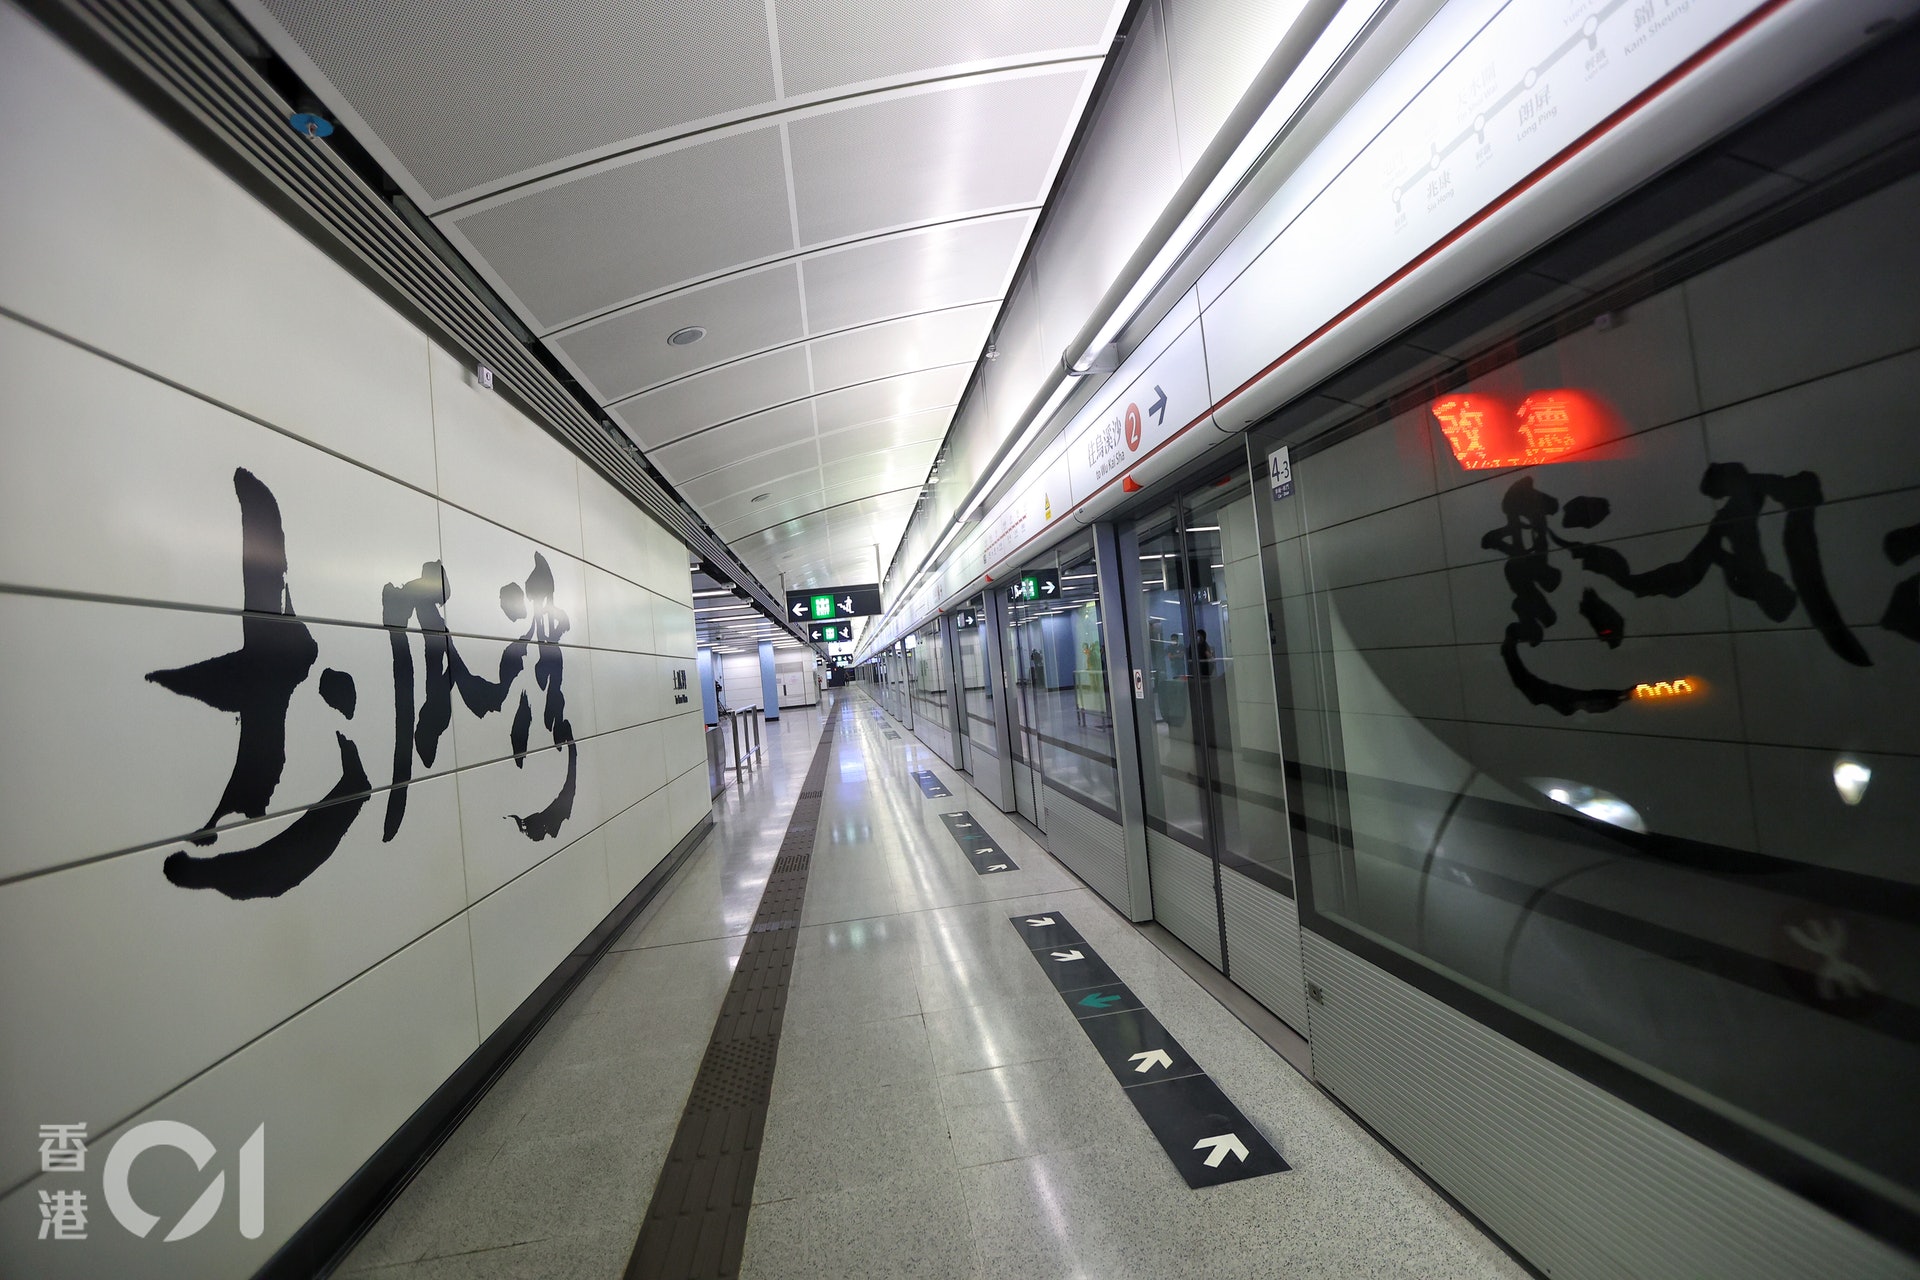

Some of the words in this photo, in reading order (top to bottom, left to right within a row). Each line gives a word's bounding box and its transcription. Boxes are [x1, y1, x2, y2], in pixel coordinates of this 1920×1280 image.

[1623, 35, 1647, 56] Kam
[1519, 83, 1551, 126] 朗屏
[1517, 122, 1537, 142] Long
[1538, 106, 1558, 125] Ping
[1128, 412, 1139, 444] 2
[1271, 456, 1290, 482] 4-3
